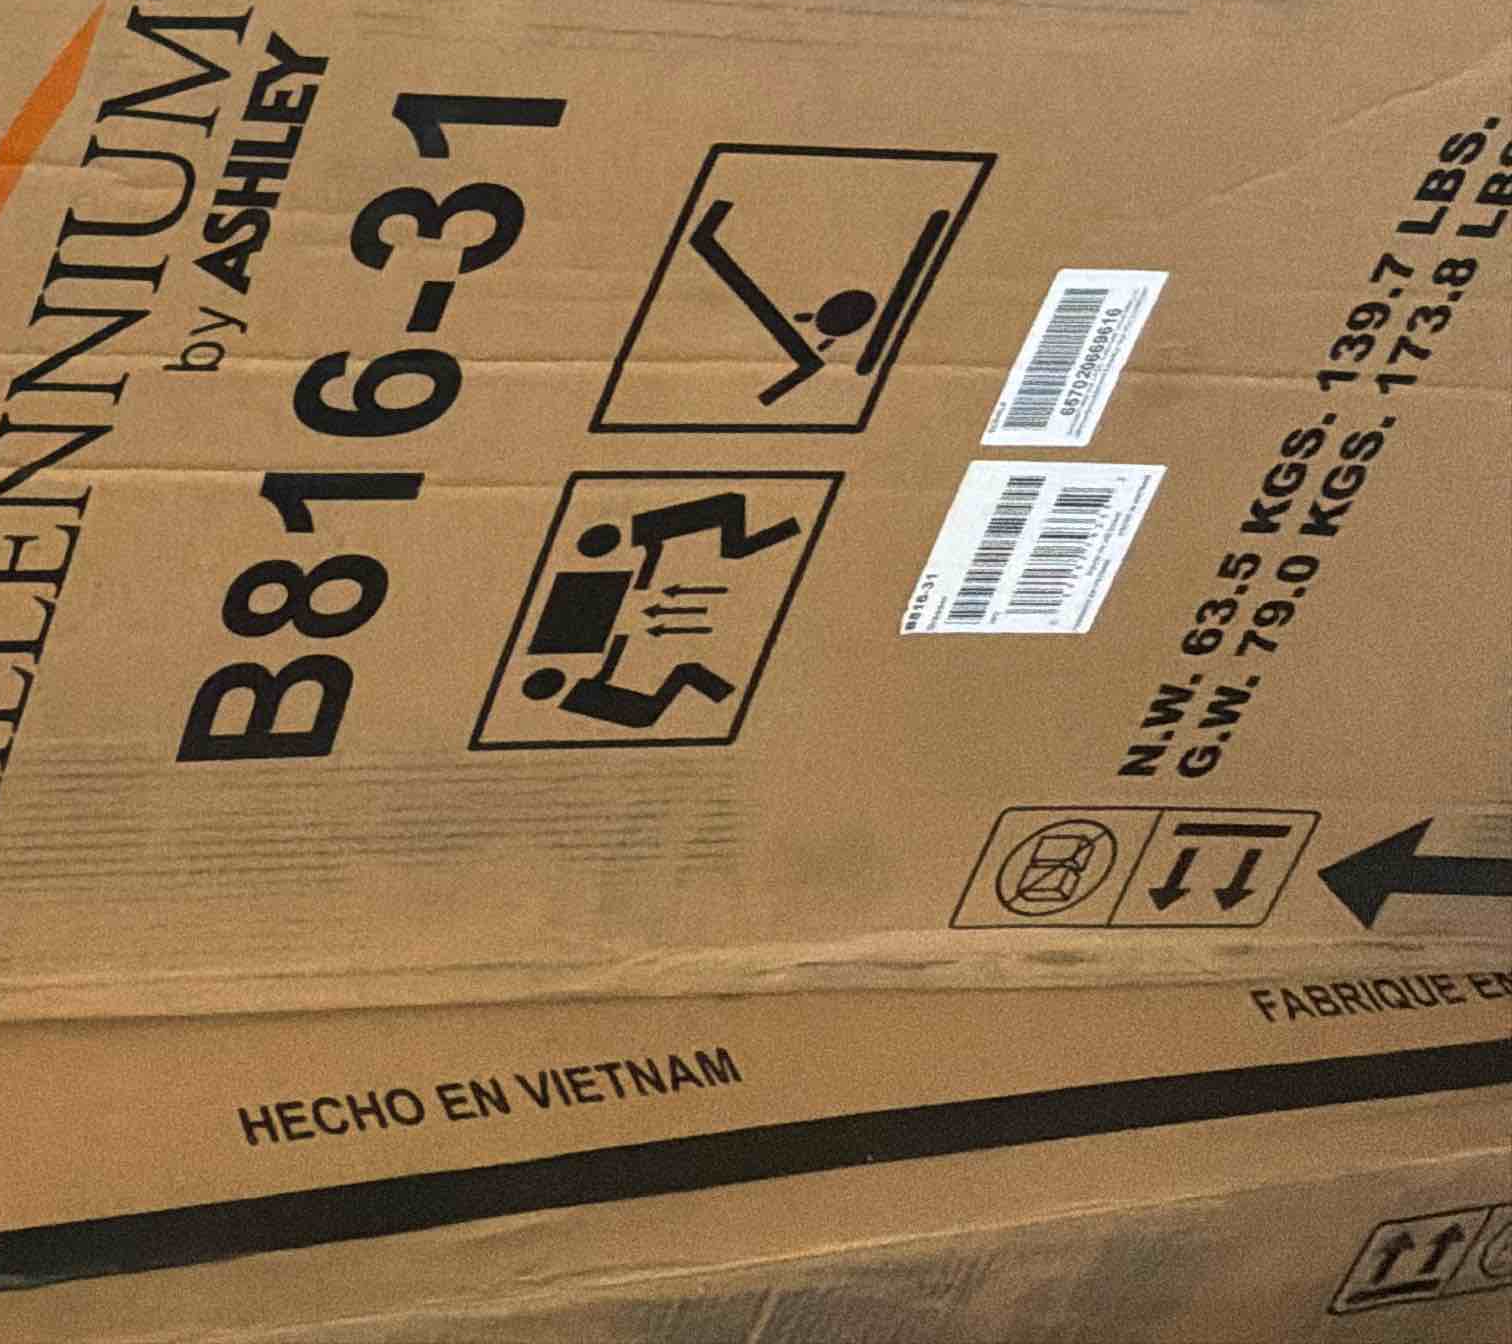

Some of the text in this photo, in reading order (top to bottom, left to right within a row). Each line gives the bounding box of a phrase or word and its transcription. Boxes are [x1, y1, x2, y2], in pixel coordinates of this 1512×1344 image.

[163, 29, 332, 376] by ASHLEY
[177, 90, 569, 763] B816-31
[1117, 115, 1502, 778] N.W. 63.5 KGS. 139.7 LBS.
[1177, 674, 1262, 779] G.W.
[1234, 553, 1321, 658] 79.0
[1300, 415, 1397, 536] KGS.
[1376, 256, 1479, 394] 173.8
[237, 1045, 745, 1148] HECHO EN VIETNAM
